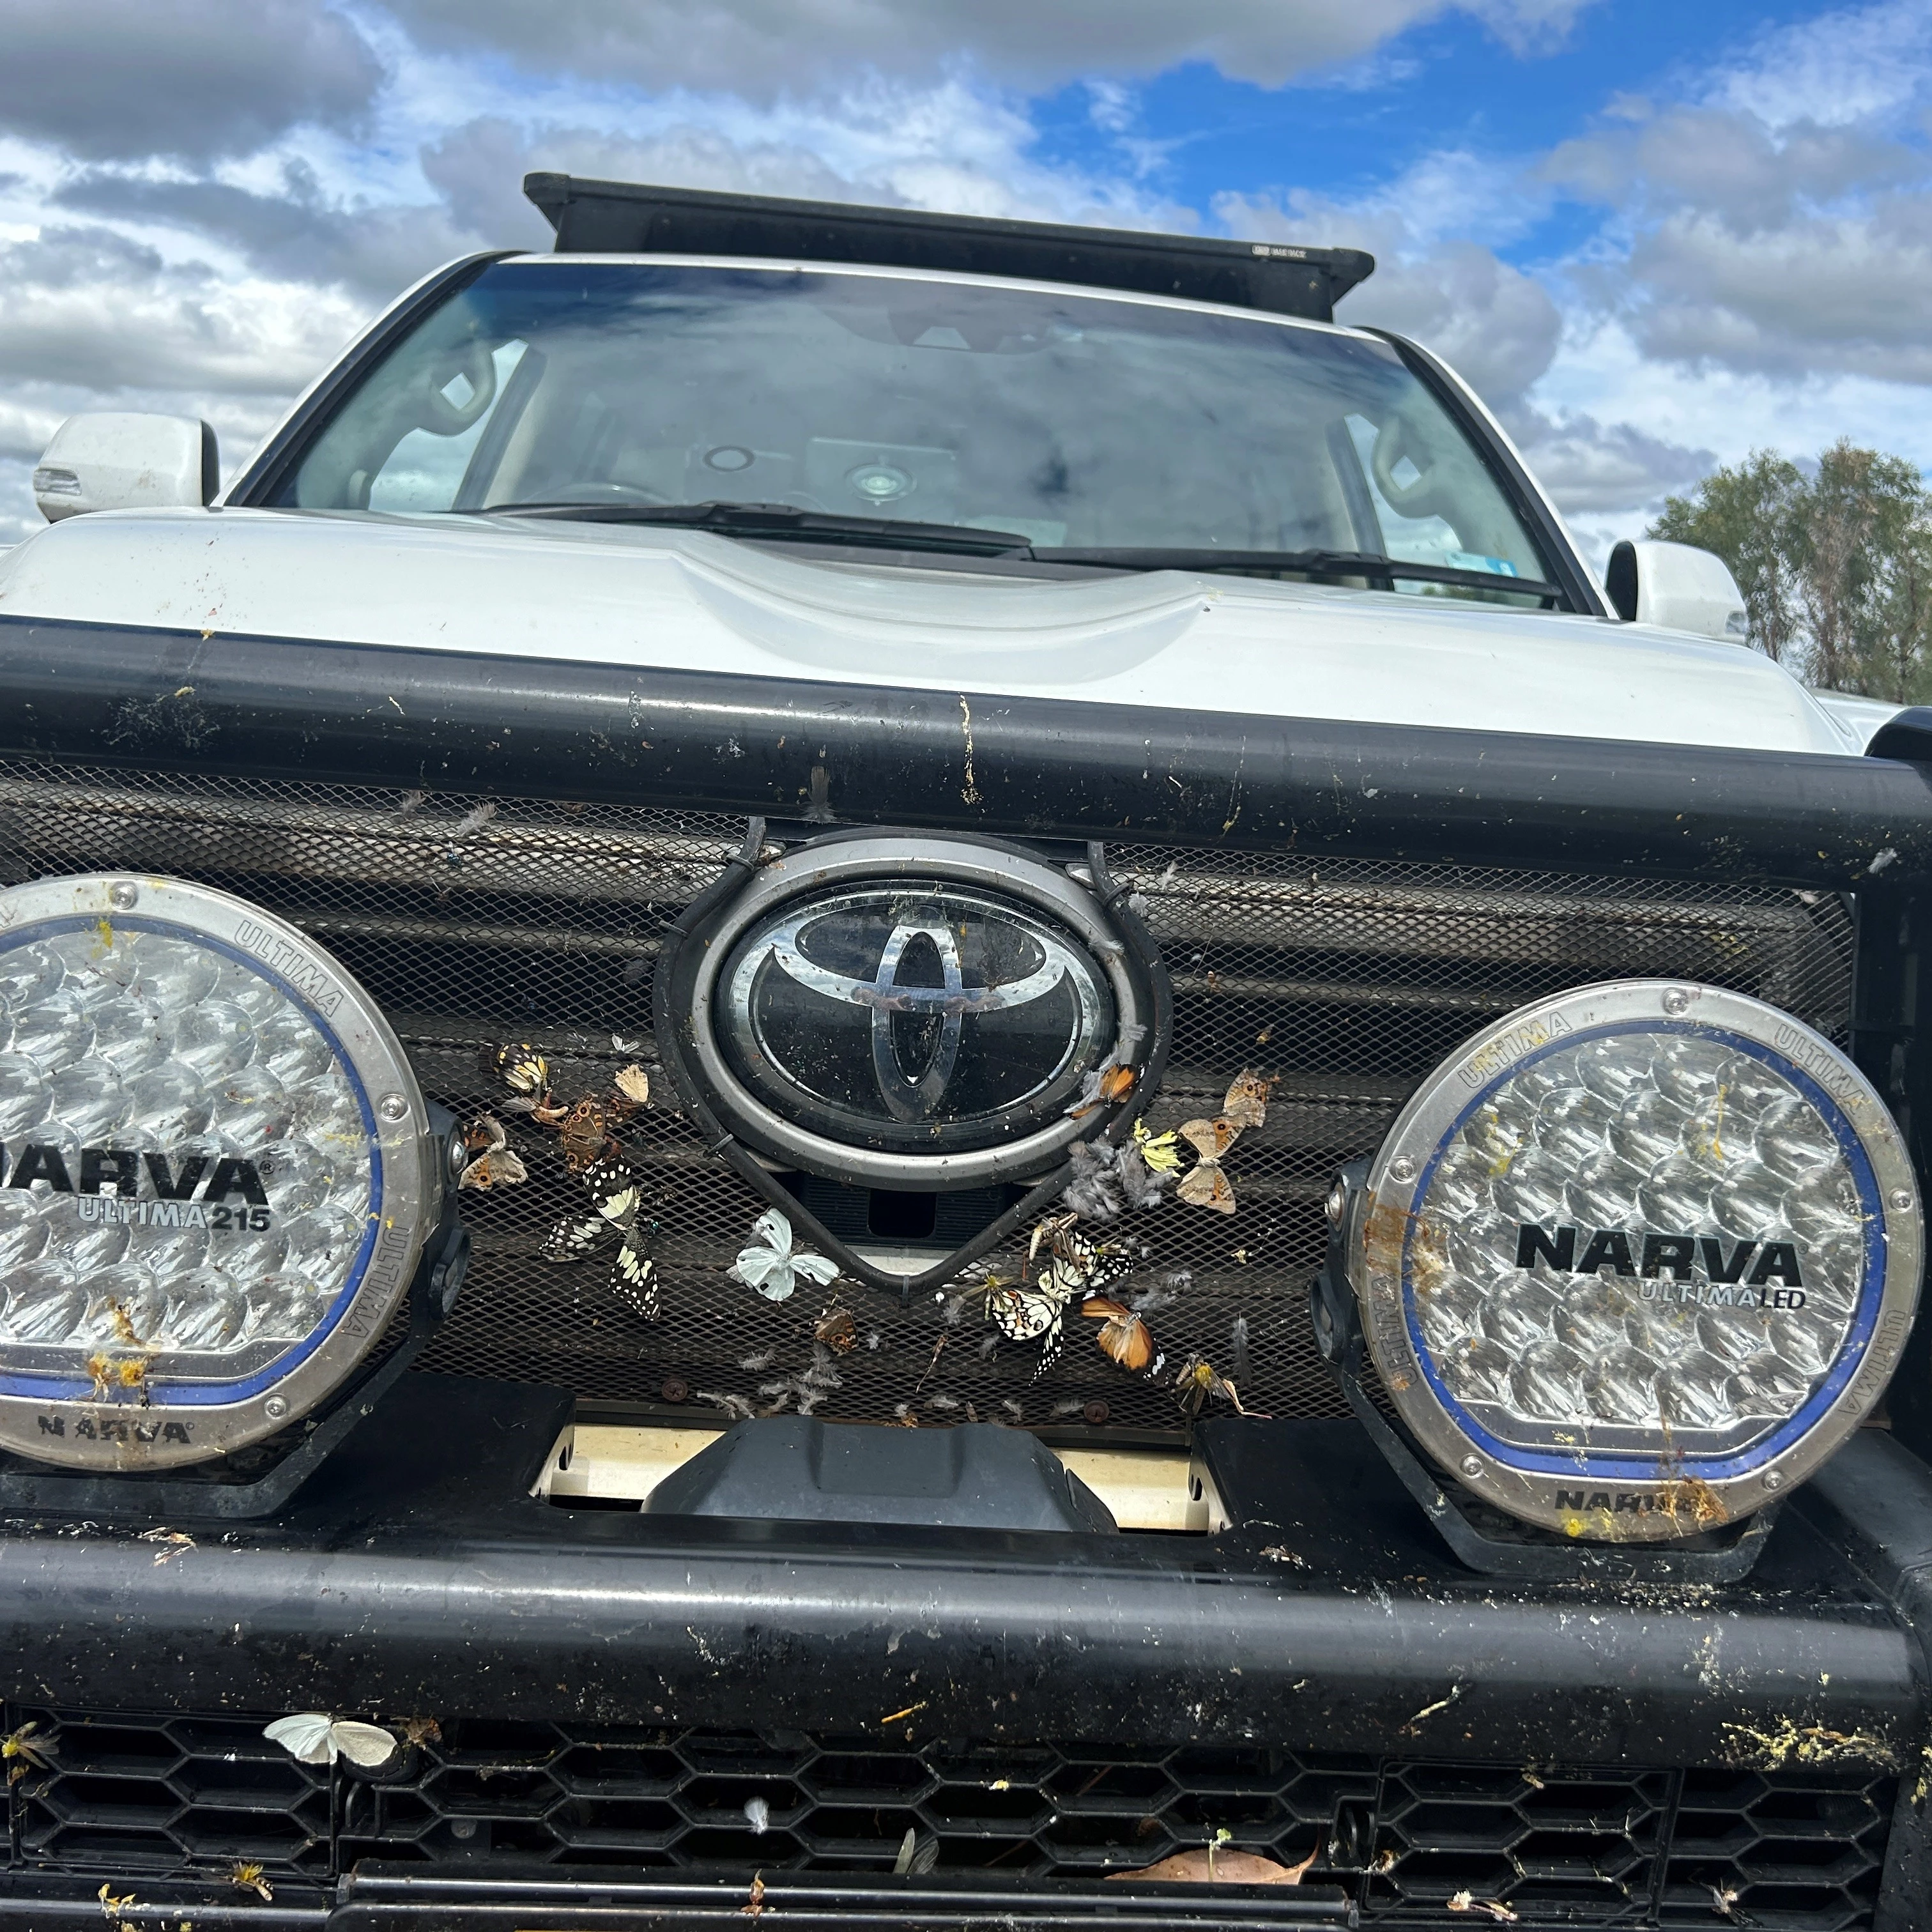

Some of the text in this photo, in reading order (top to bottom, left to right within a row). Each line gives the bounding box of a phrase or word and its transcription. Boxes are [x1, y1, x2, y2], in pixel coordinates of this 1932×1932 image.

[234, 920, 344, 1017] ULTIMA
[1457, 1011, 1572, 1088] ULTIMA
[1774, 1023, 1866, 1115] ULTIMA
[0, 1142, 269, 1206] ARVA
[342, 1226, 410, 1338] ULTIMA
[1515, 1223, 1803, 1287] NARVA
[1838, 1310, 1906, 1414] ULTIMA
